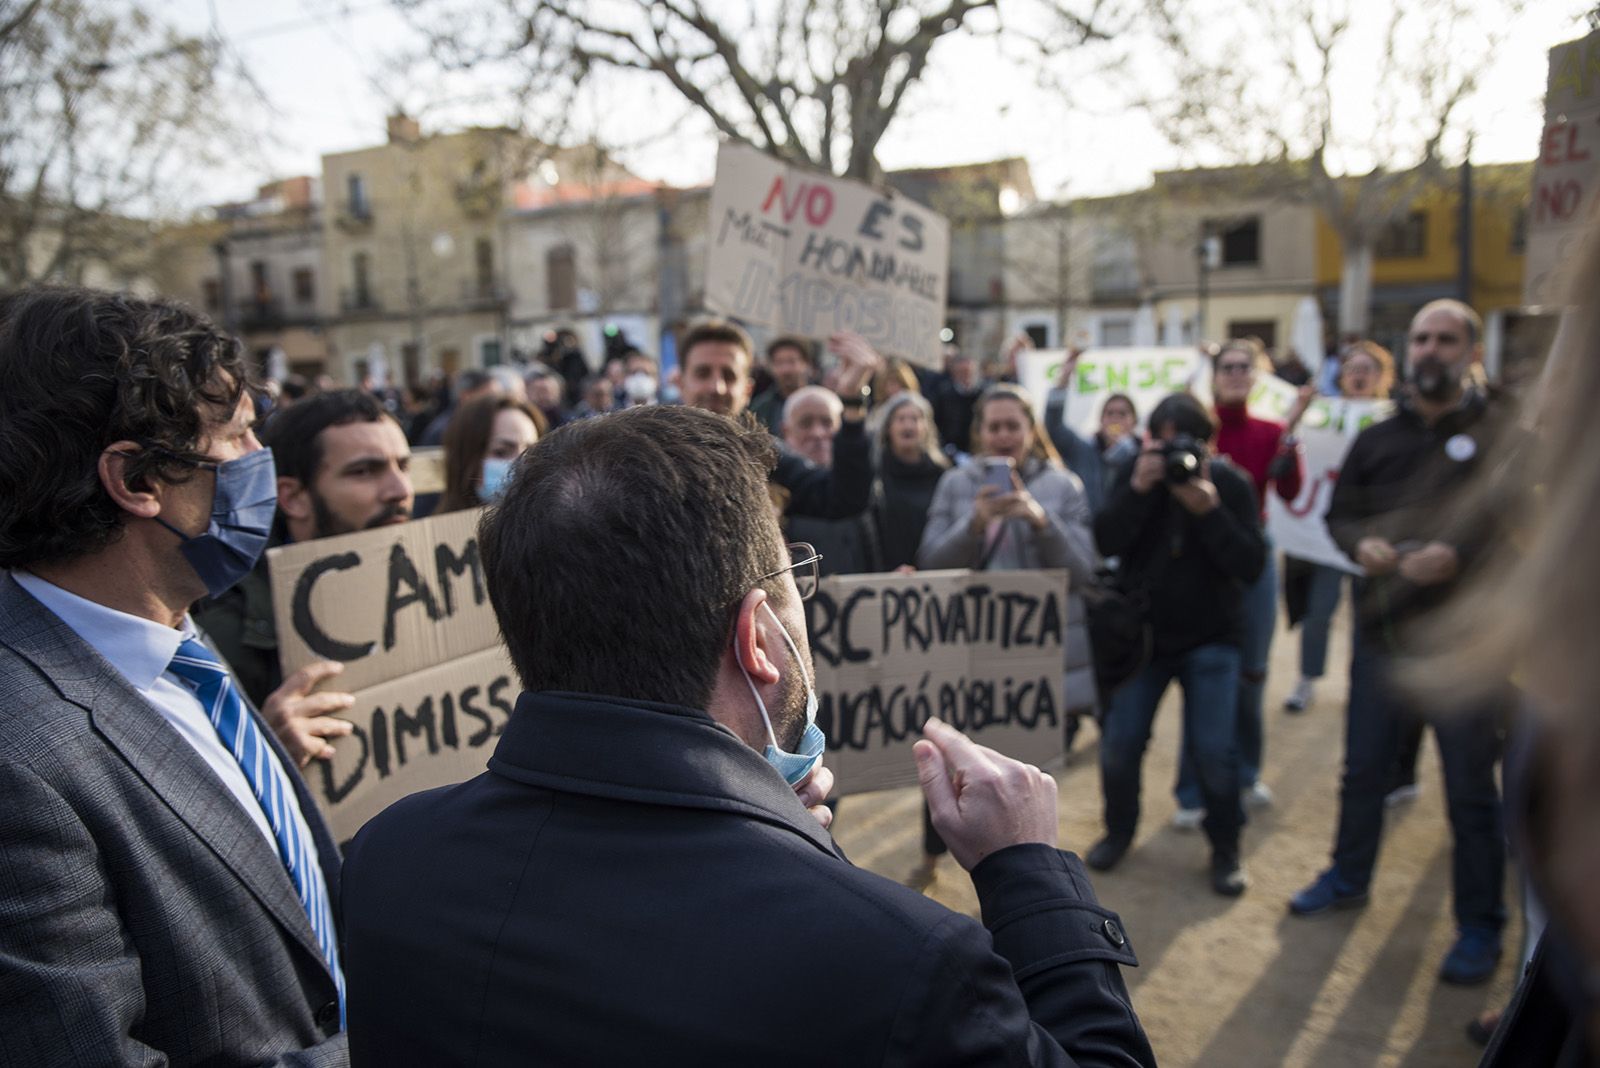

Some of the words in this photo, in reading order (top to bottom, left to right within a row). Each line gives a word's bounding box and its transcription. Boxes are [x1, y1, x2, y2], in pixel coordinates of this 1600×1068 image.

[1544, 122, 1590, 167] EL
[762, 175, 835, 228] NO
[1536, 178, 1582, 225] NO
[800, 582, 875, 667] RC
[817, 671, 932, 750] UCACIÓ
